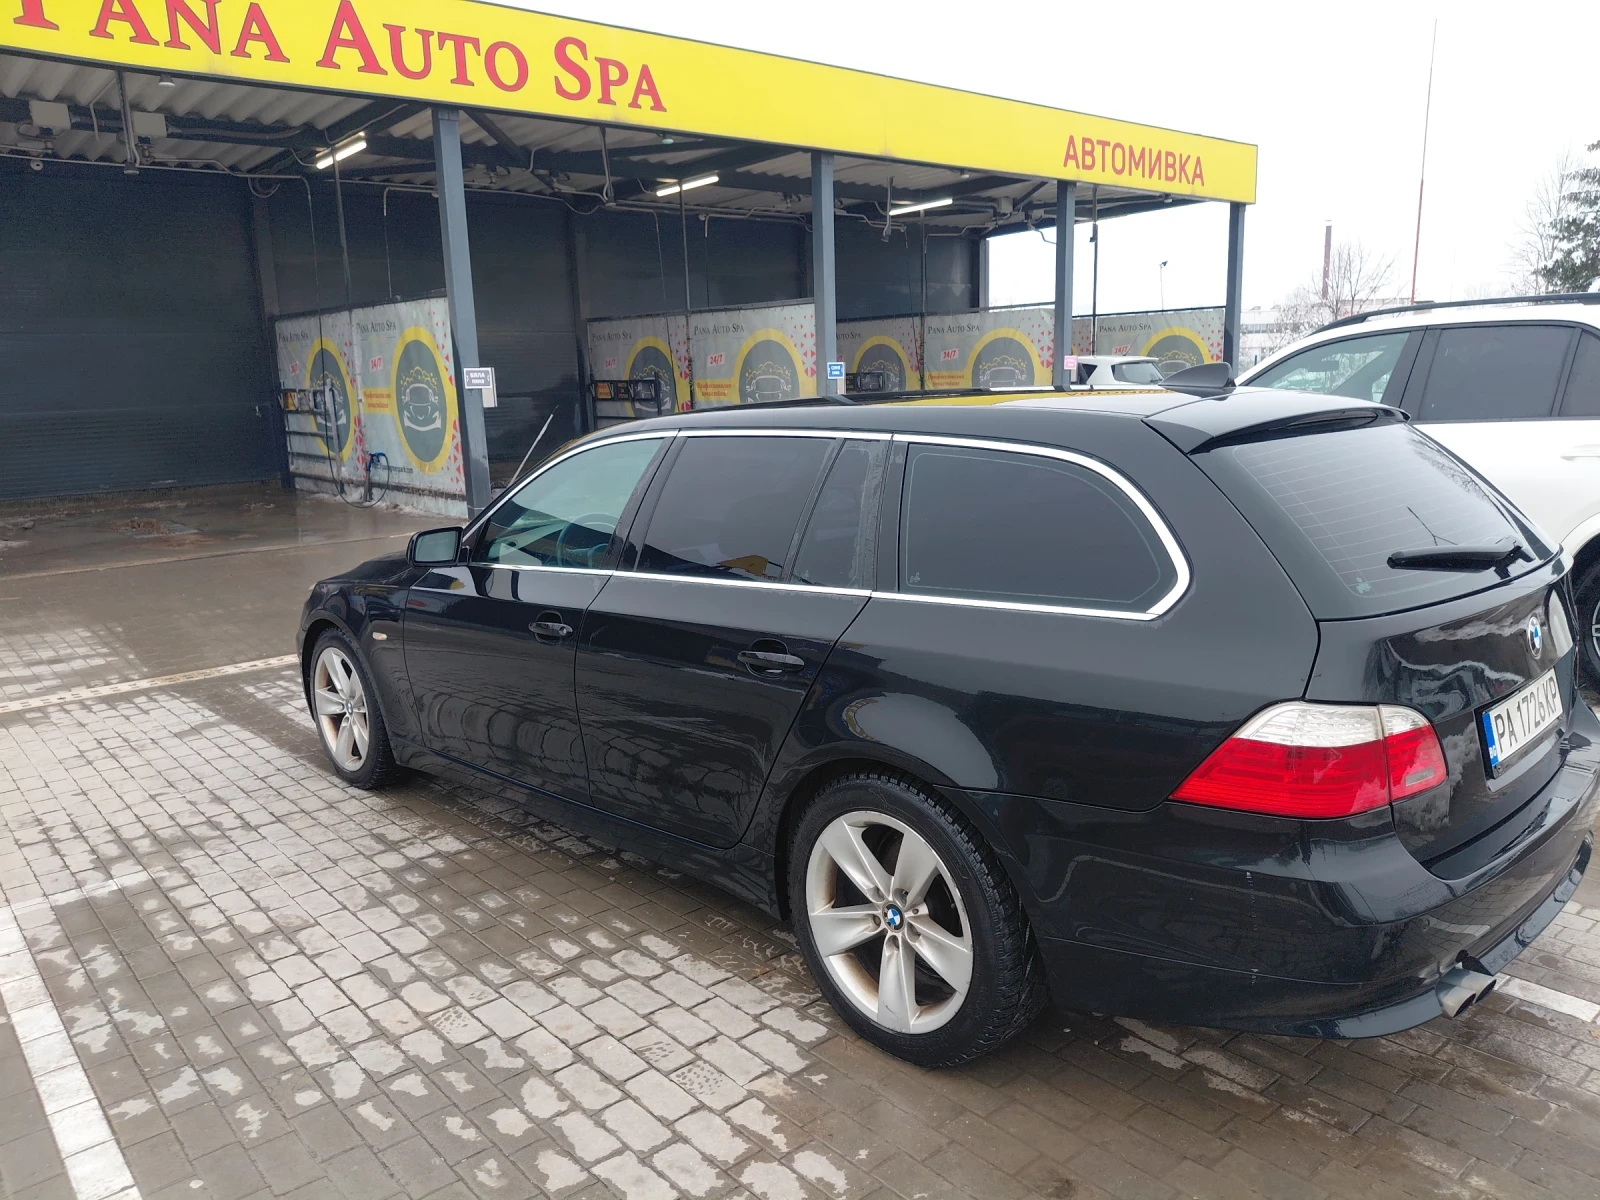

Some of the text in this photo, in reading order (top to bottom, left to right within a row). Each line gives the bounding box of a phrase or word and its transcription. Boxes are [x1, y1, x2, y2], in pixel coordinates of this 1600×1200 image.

[316, 0, 529, 92] AUTO
[554, 36, 667, 112] SPA
[1063, 135, 1205, 187] АВТОМИВКА
[1494, 676, 1557, 754] PA 1726 KP
[1488, 744, 1498, 760] BG
